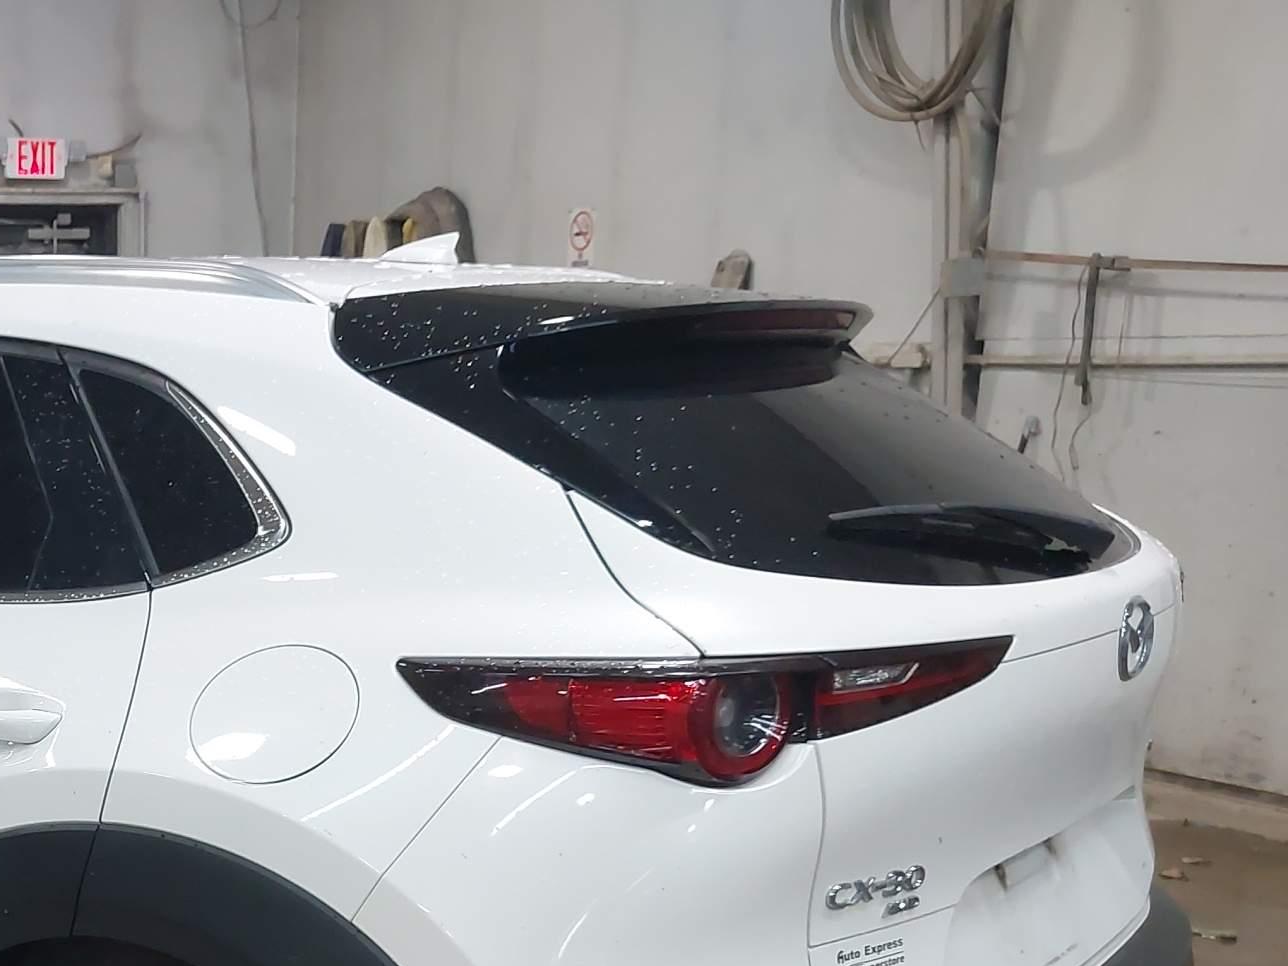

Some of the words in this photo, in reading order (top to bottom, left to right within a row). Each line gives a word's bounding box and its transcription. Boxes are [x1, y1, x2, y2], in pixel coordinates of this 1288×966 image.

[18, 140, 56, 175] EXIT
[825, 865, 926, 911] CX-30
[837, 950, 861, 964] Auto
[864, 938, 904, 956] Express
